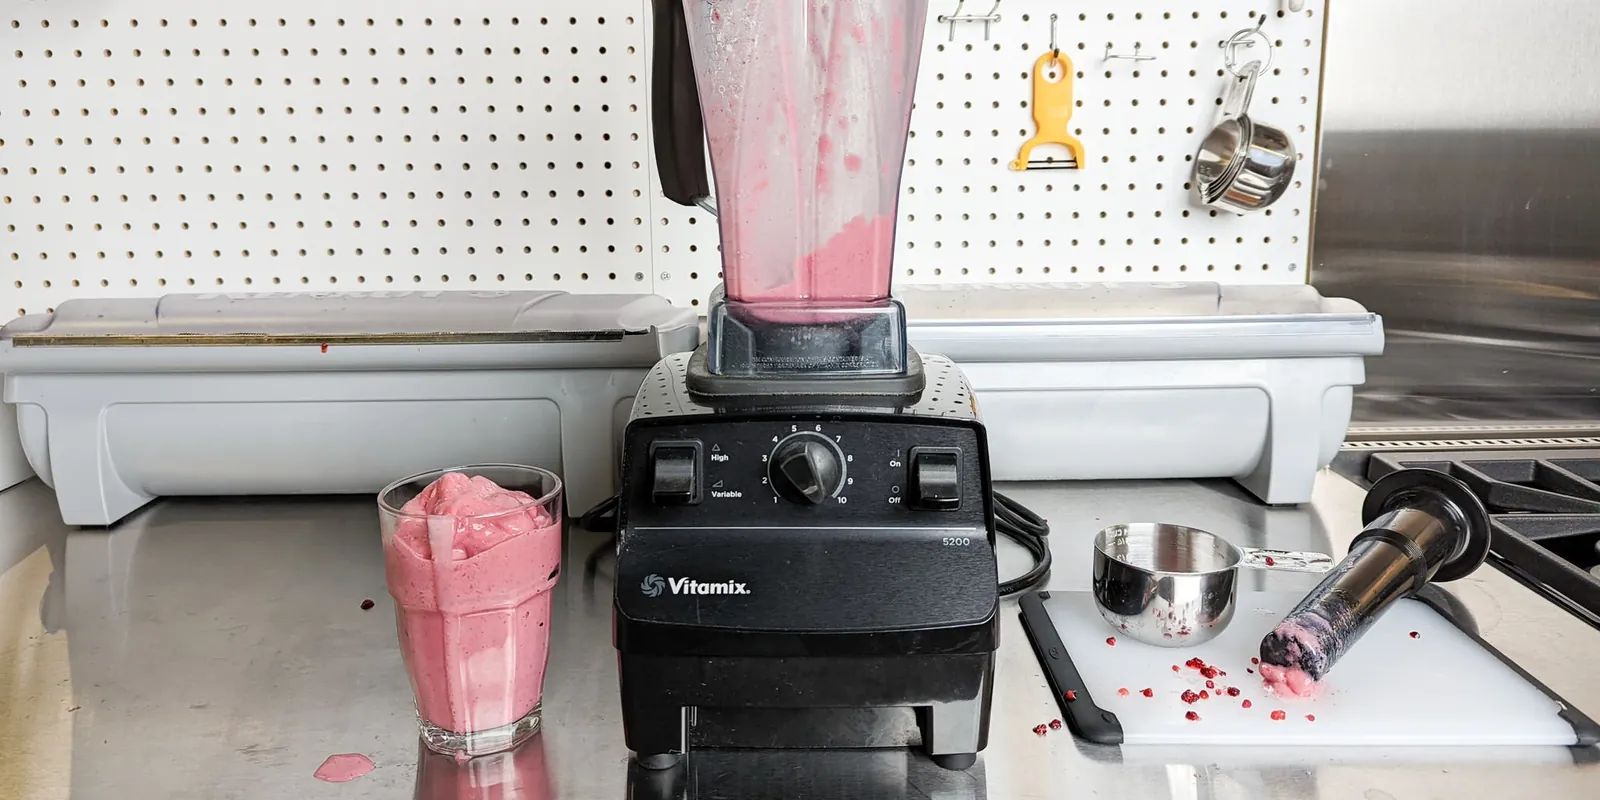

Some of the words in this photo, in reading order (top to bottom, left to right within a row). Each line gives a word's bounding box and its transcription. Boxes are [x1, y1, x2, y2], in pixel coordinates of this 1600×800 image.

[711, 453, 729, 462] High
[711, 490, 743, 498] Variable
[773, 496, 777, 504] 1
[837, 496, 847, 504] 10
[888, 496, 901, 504] Off
[942, 537, 970, 546] 5200
